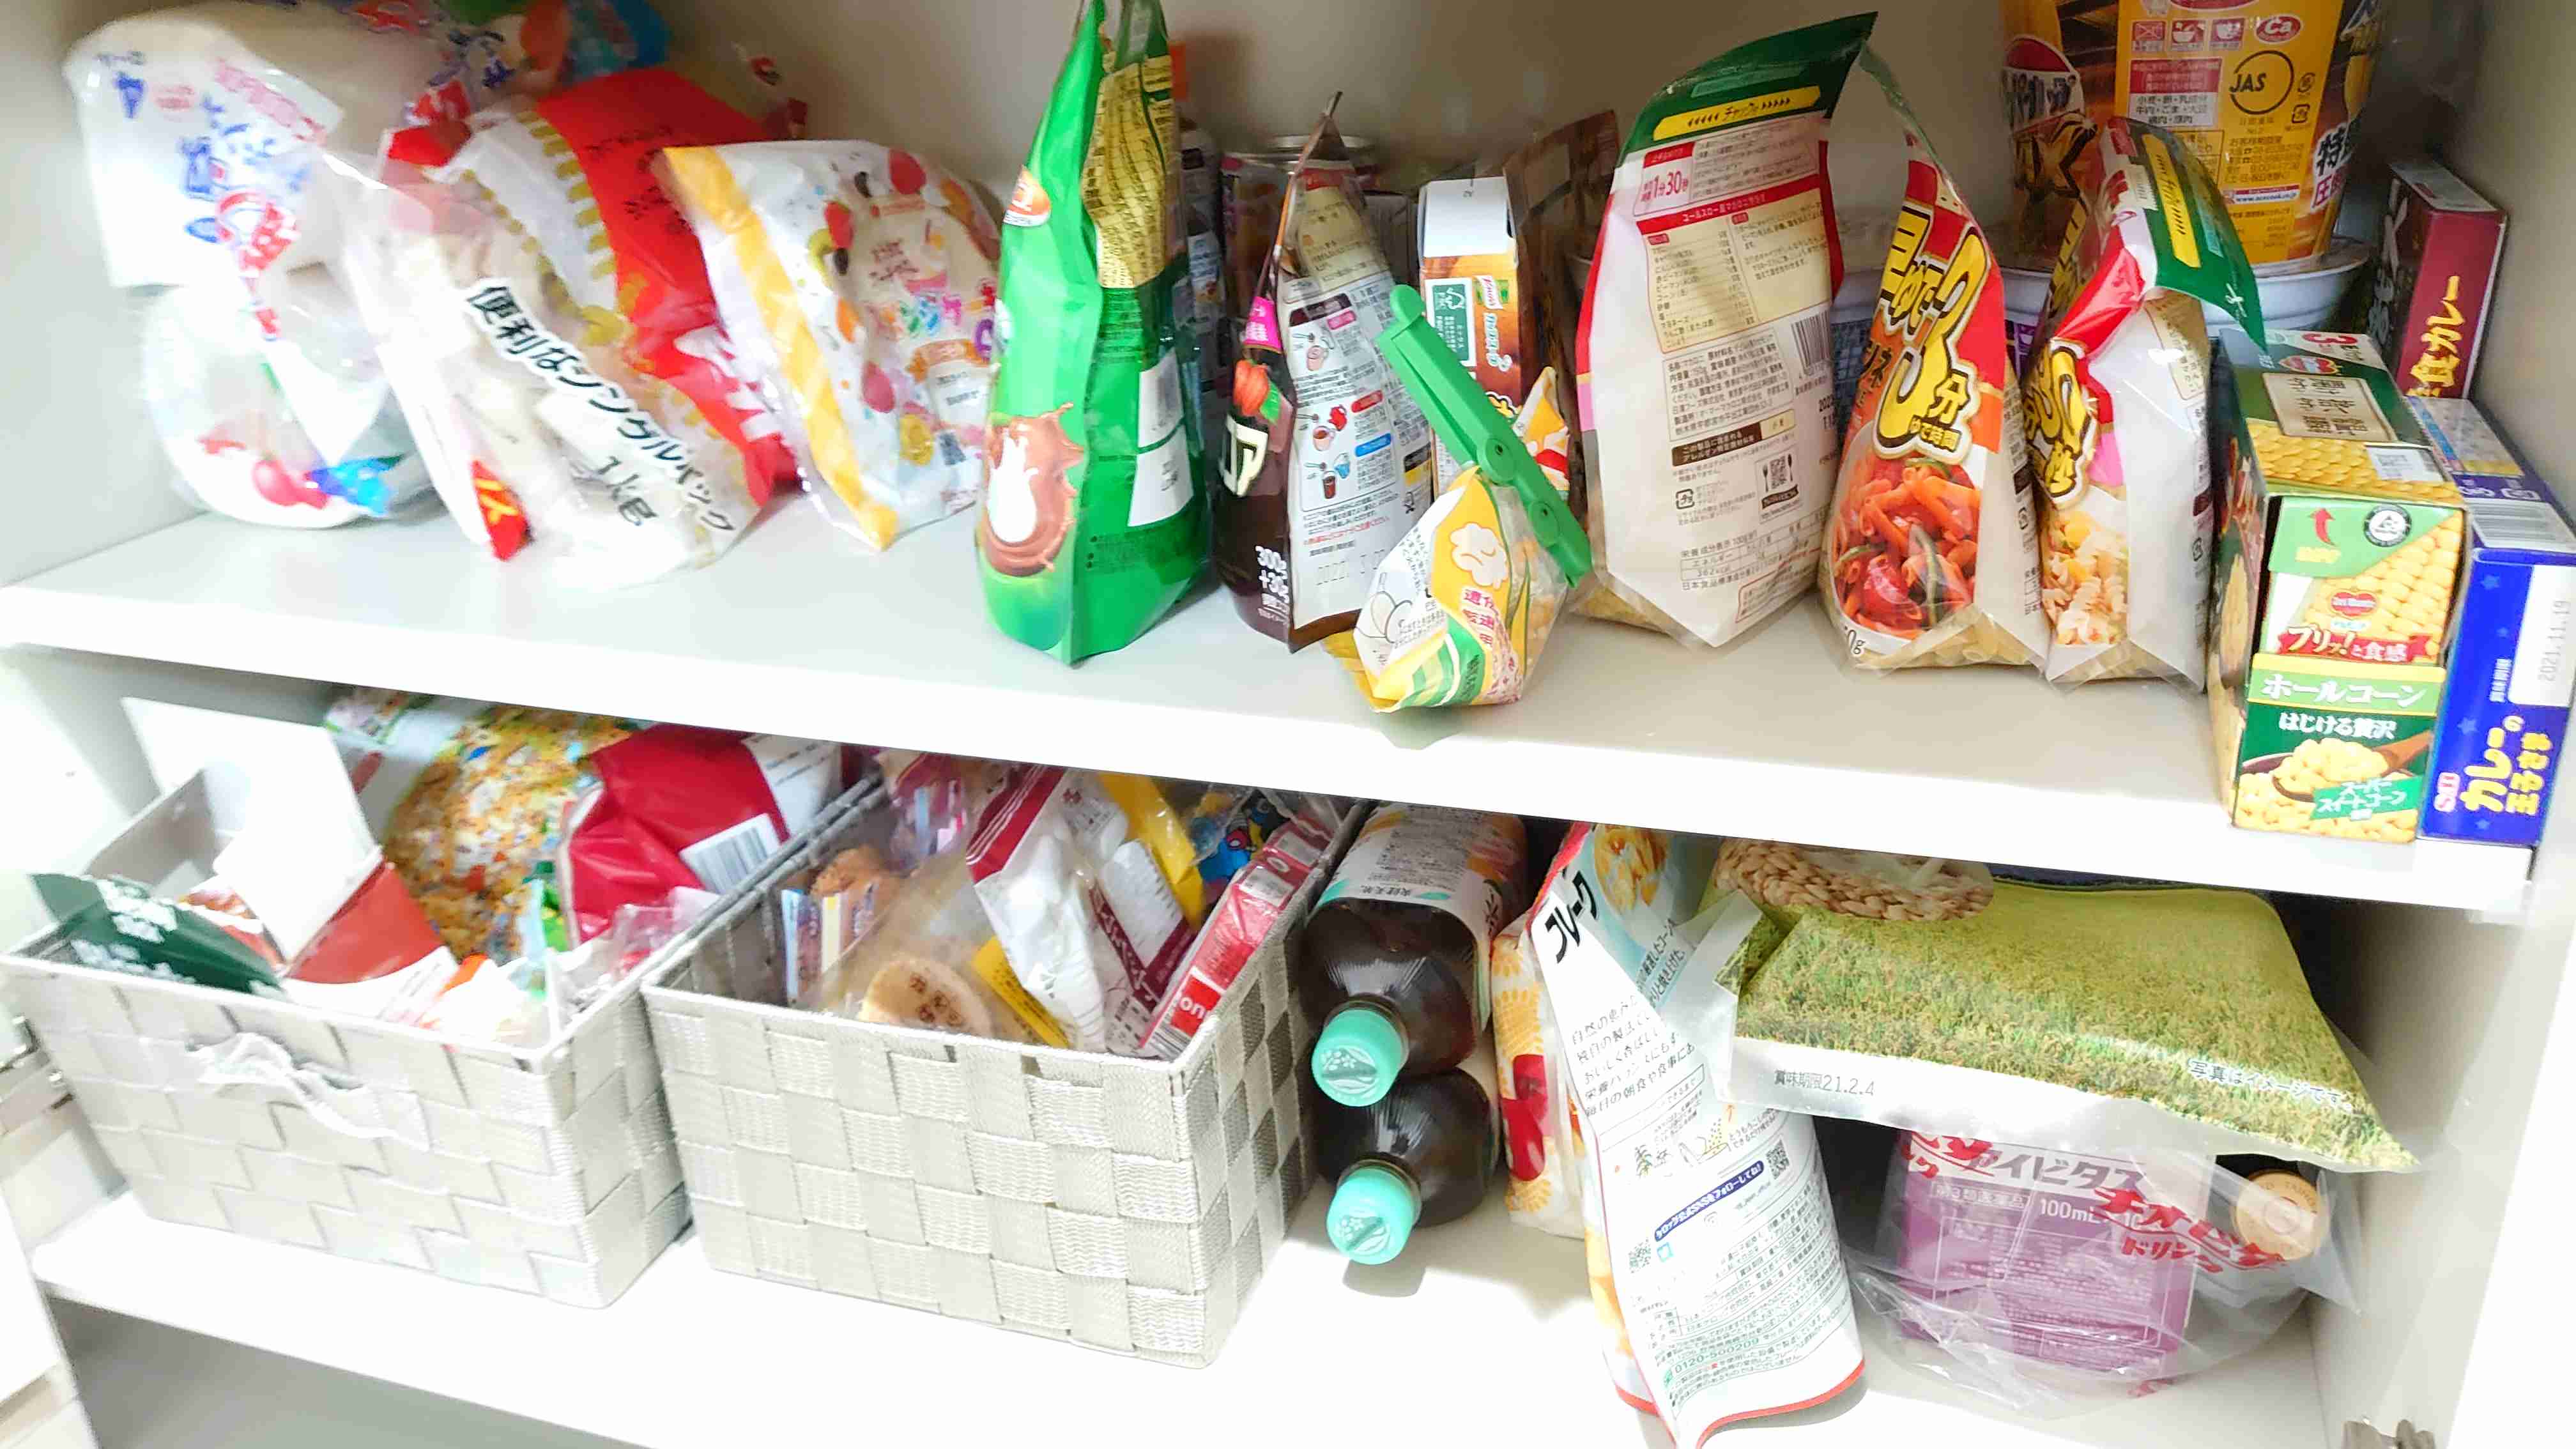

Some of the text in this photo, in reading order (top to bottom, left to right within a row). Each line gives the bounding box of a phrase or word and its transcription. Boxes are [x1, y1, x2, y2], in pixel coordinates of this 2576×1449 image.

[2230, 73, 2266, 93] JAS
[467, 286, 735, 532] 便利なシングルパック
[2262, 673, 2427, 707] ホールコーン
[2278, 712, 2398, 740] はじける贅沢
